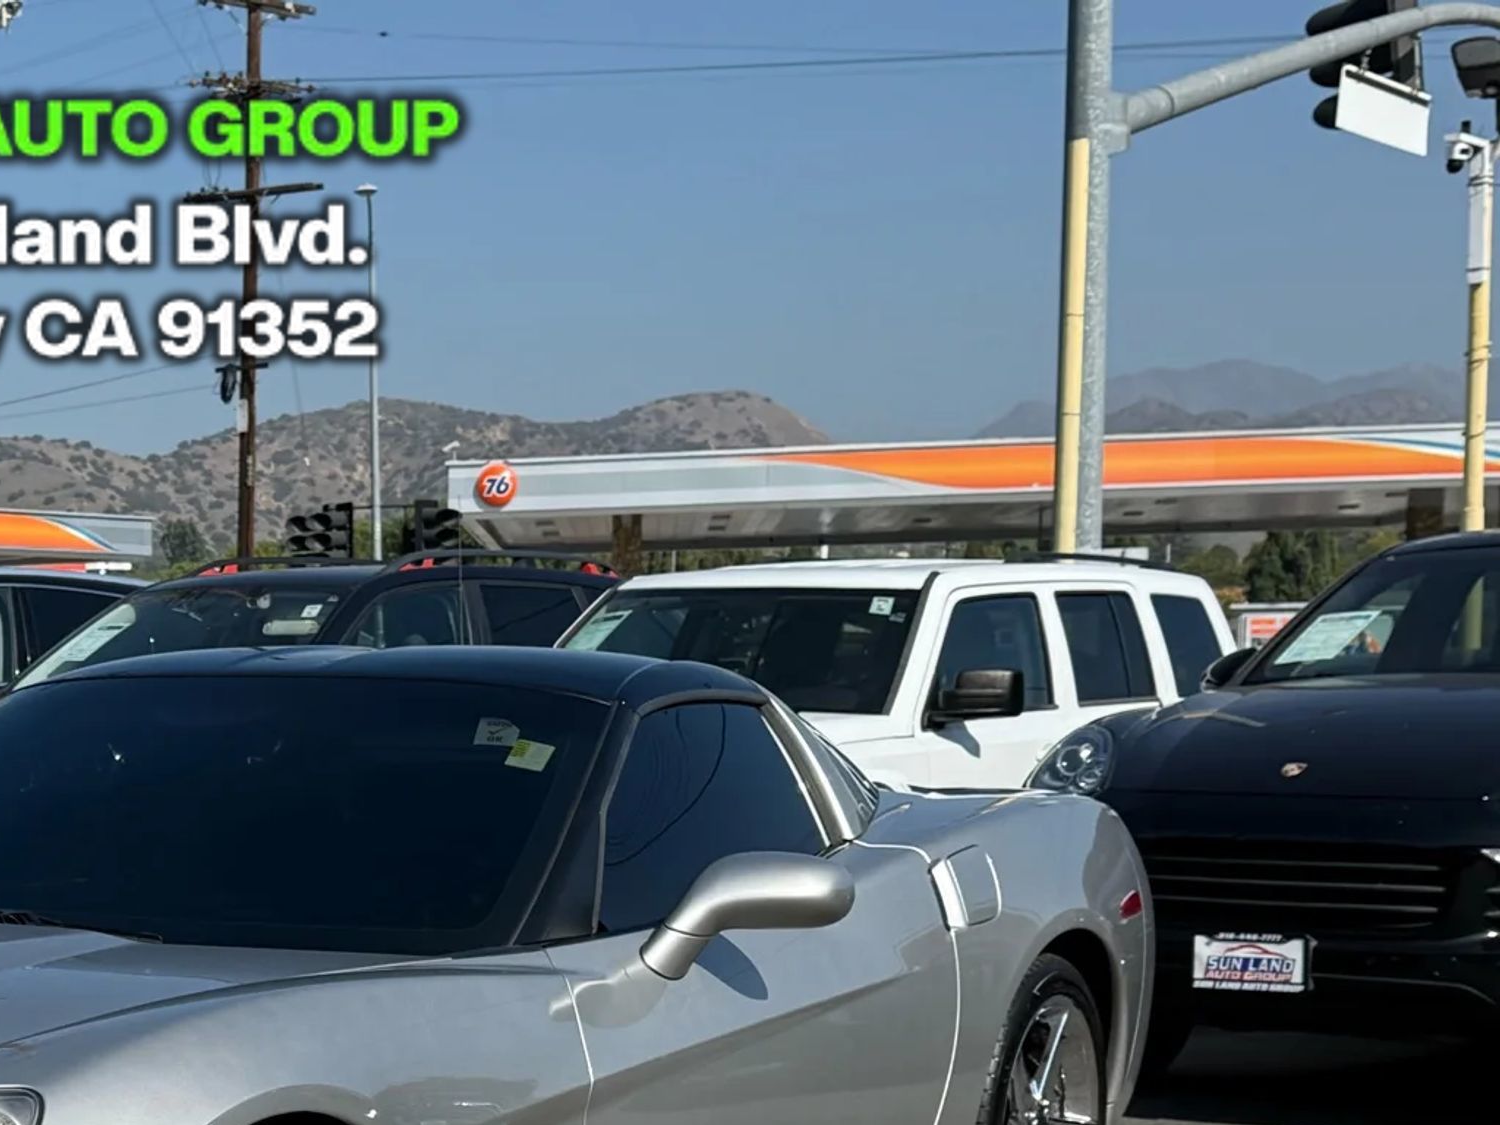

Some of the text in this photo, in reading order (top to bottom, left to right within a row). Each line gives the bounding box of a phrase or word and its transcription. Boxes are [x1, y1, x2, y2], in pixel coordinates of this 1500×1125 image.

[484, 475, 511, 496] 76
[1207, 956, 1295, 974] SUN LAND
[1205, 970, 1293, 983] AUTO GROUP
